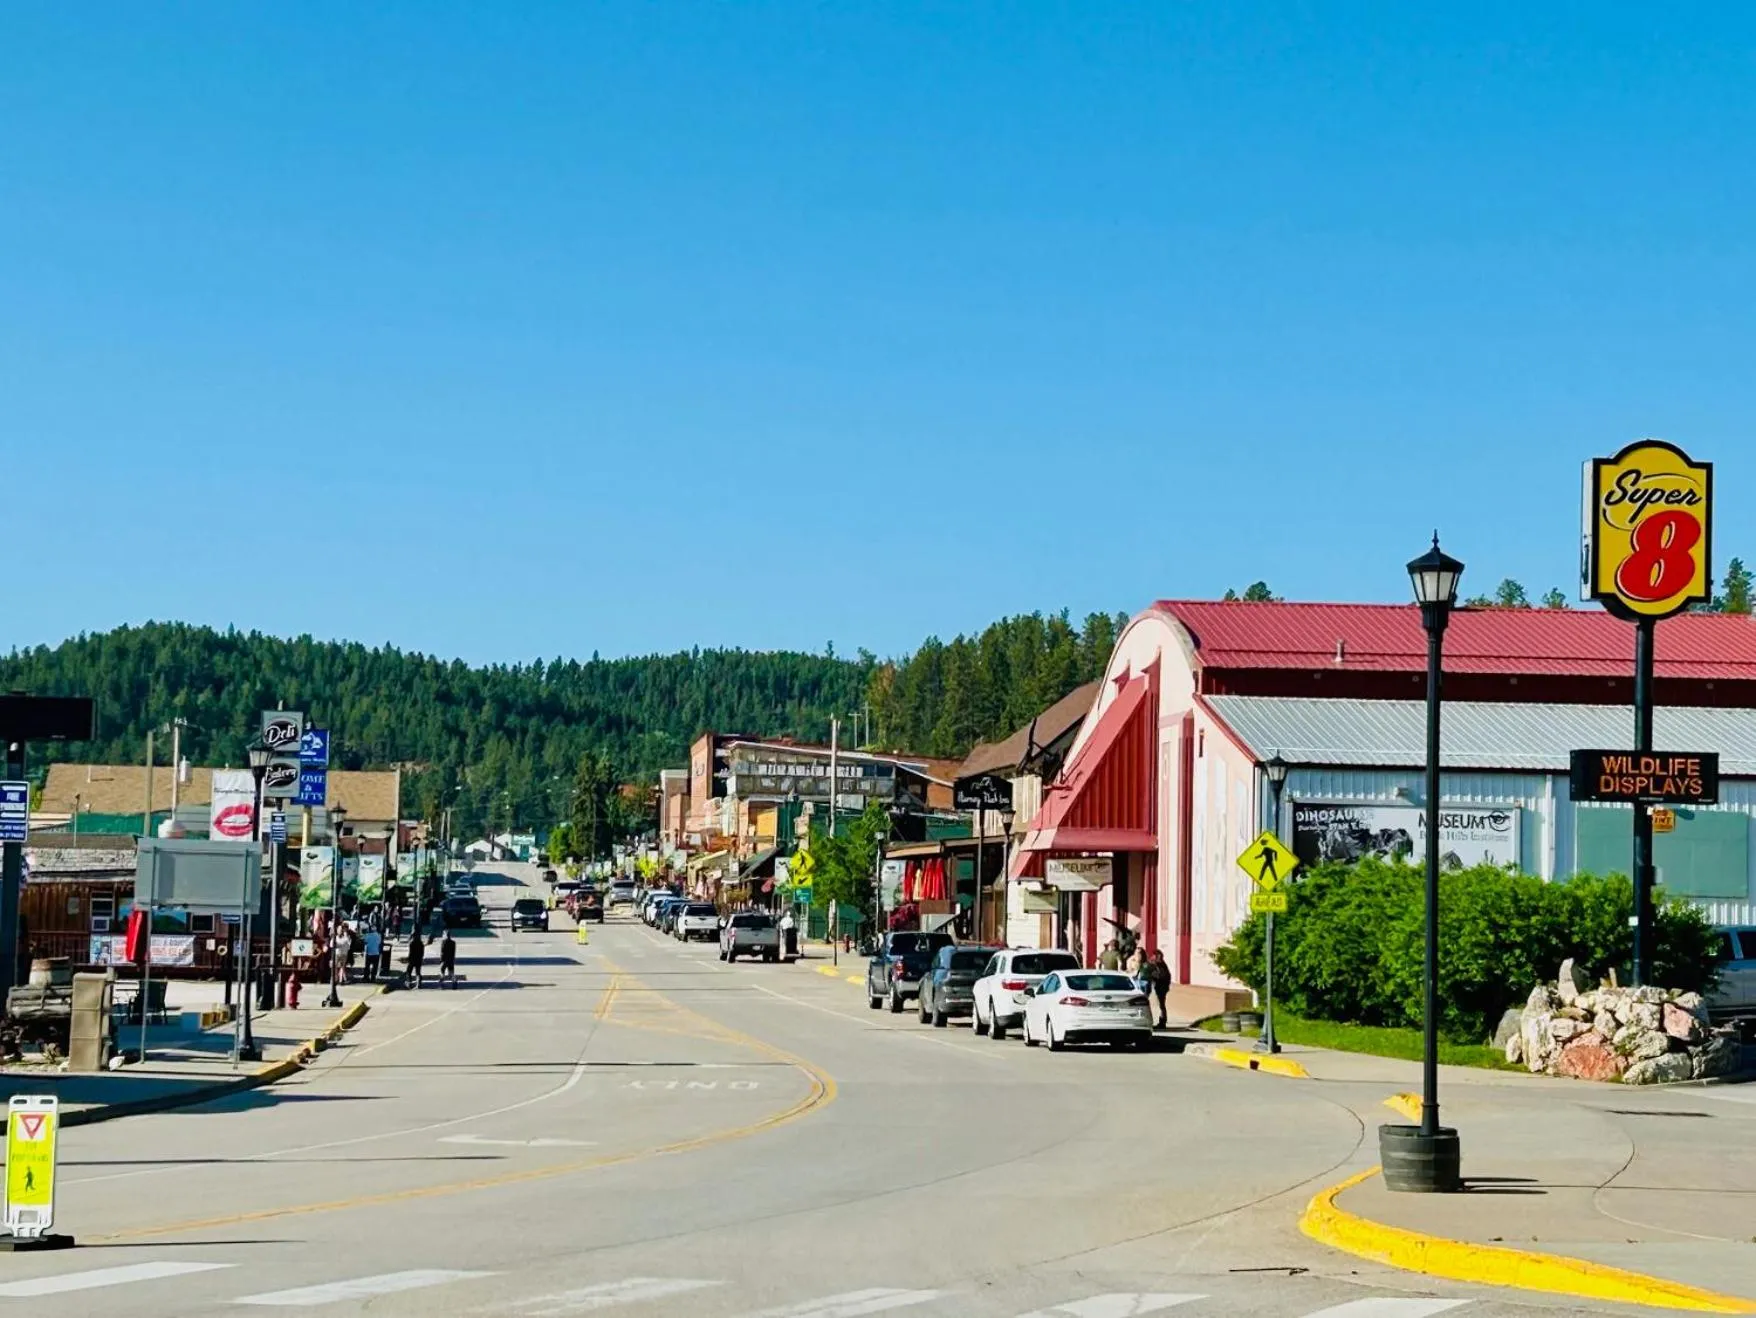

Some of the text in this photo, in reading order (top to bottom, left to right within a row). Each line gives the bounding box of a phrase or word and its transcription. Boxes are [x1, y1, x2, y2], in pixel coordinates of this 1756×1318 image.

[1604, 469, 1702, 524] Super
[1614, 510, 1701, 602] 8
[265, 724, 296, 743] Deli
[1602, 757, 1700, 775] WILDLIFE
[301, 775, 324, 784] OME
[1600, 776, 1702, 794] DISPLAYS
